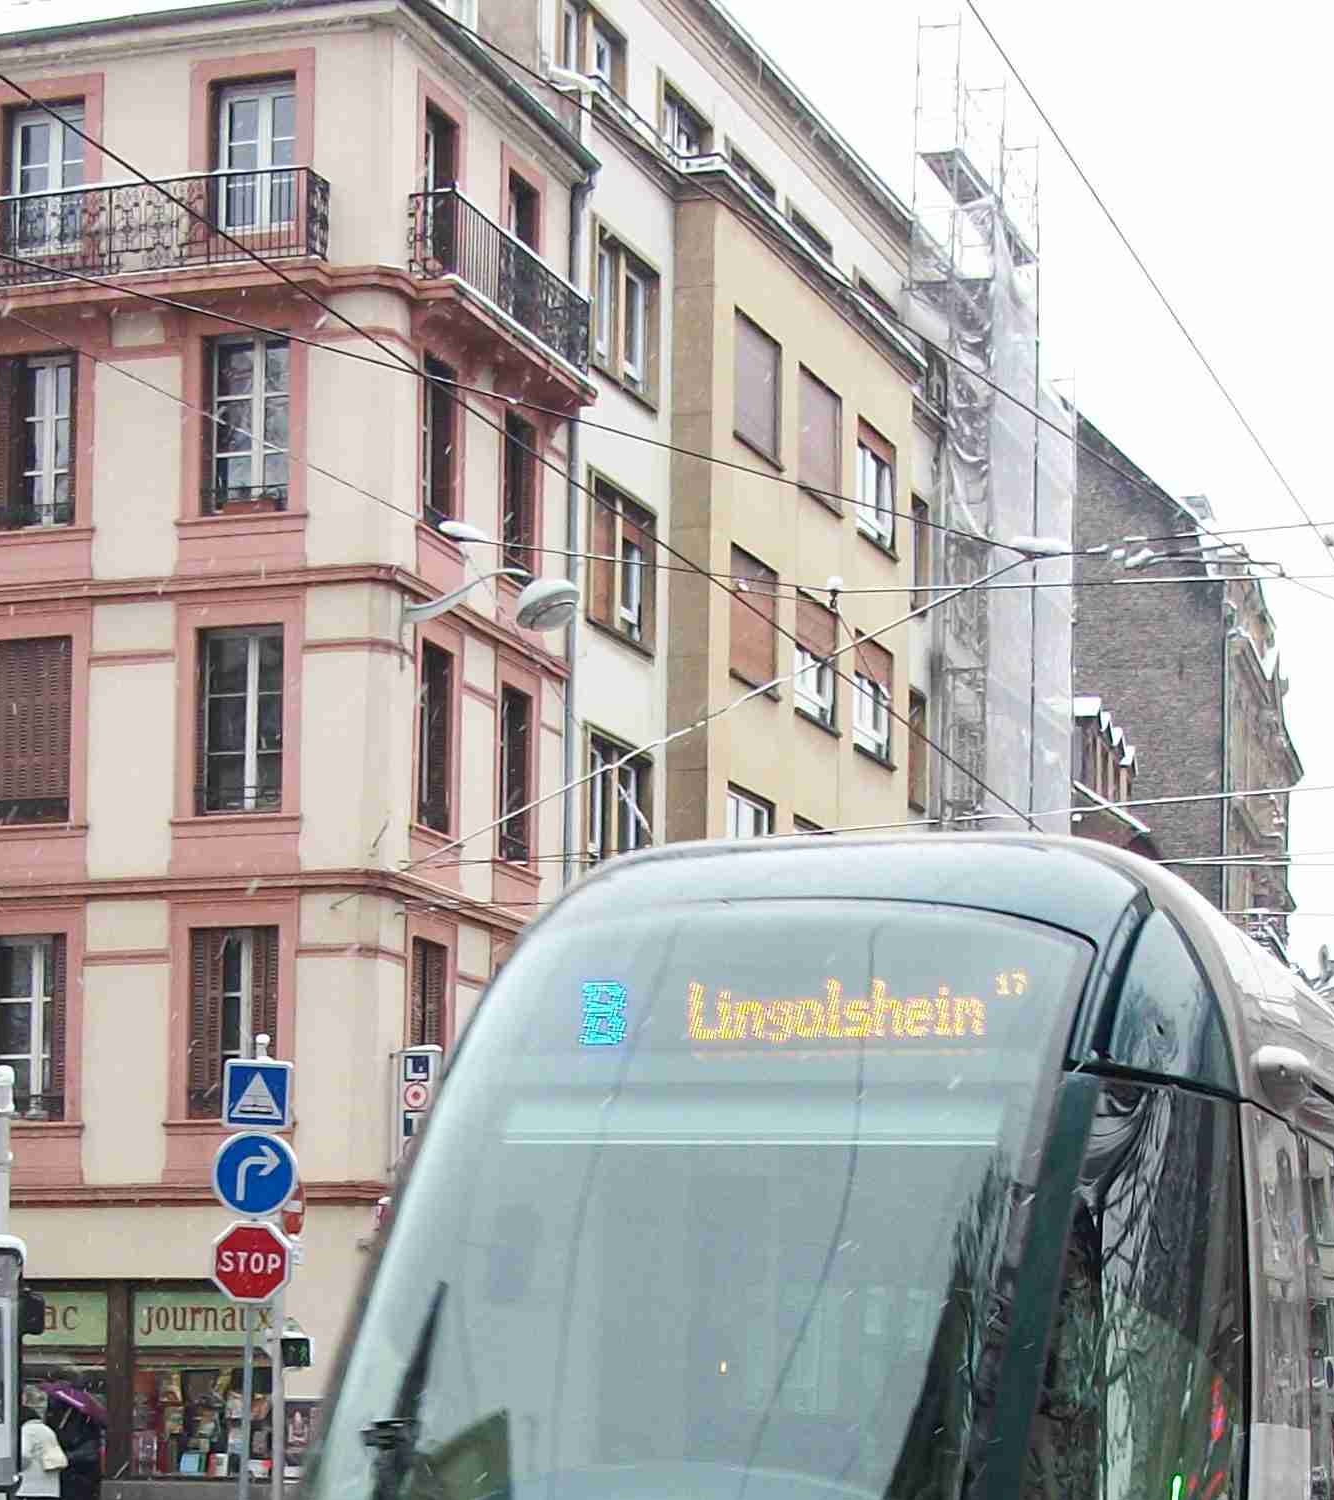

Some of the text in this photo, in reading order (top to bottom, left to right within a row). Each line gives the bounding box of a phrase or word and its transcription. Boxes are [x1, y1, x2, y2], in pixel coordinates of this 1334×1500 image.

[578, 980, 628, 1047] B
[687, 976, 988, 1041] Lingolshein
[218, 1250, 282, 1275] STOP
